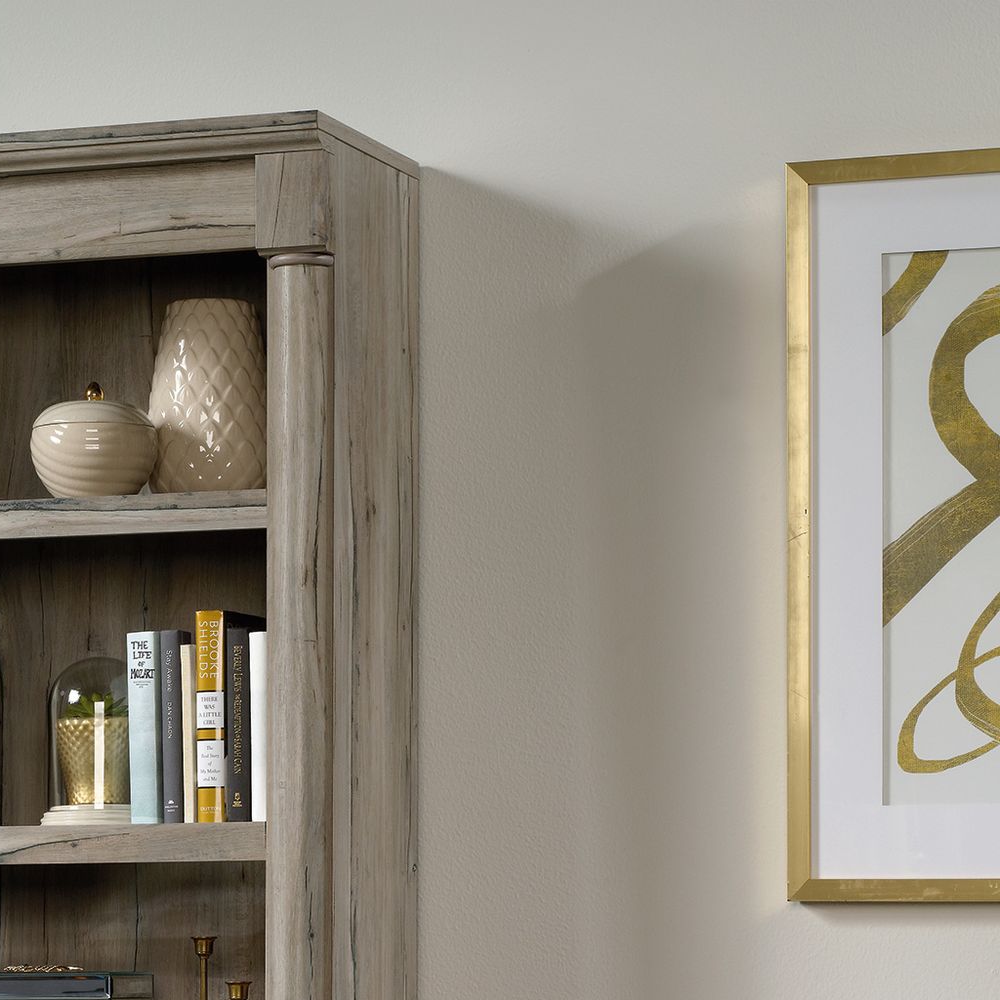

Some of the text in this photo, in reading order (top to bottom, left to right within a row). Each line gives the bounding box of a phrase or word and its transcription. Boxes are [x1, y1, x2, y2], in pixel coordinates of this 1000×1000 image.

[130, 640, 149, 650] THE
[199, 620, 209, 679] SHIELDS
[209, 620, 220, 679] BROOKE
[132, 651, 152, 660] LIFE
[165, 649, 173, 666] Stay
[130, 668, 156, 680] MOZART
[233, 645, 243, 693] BEVERLY LEWIS
